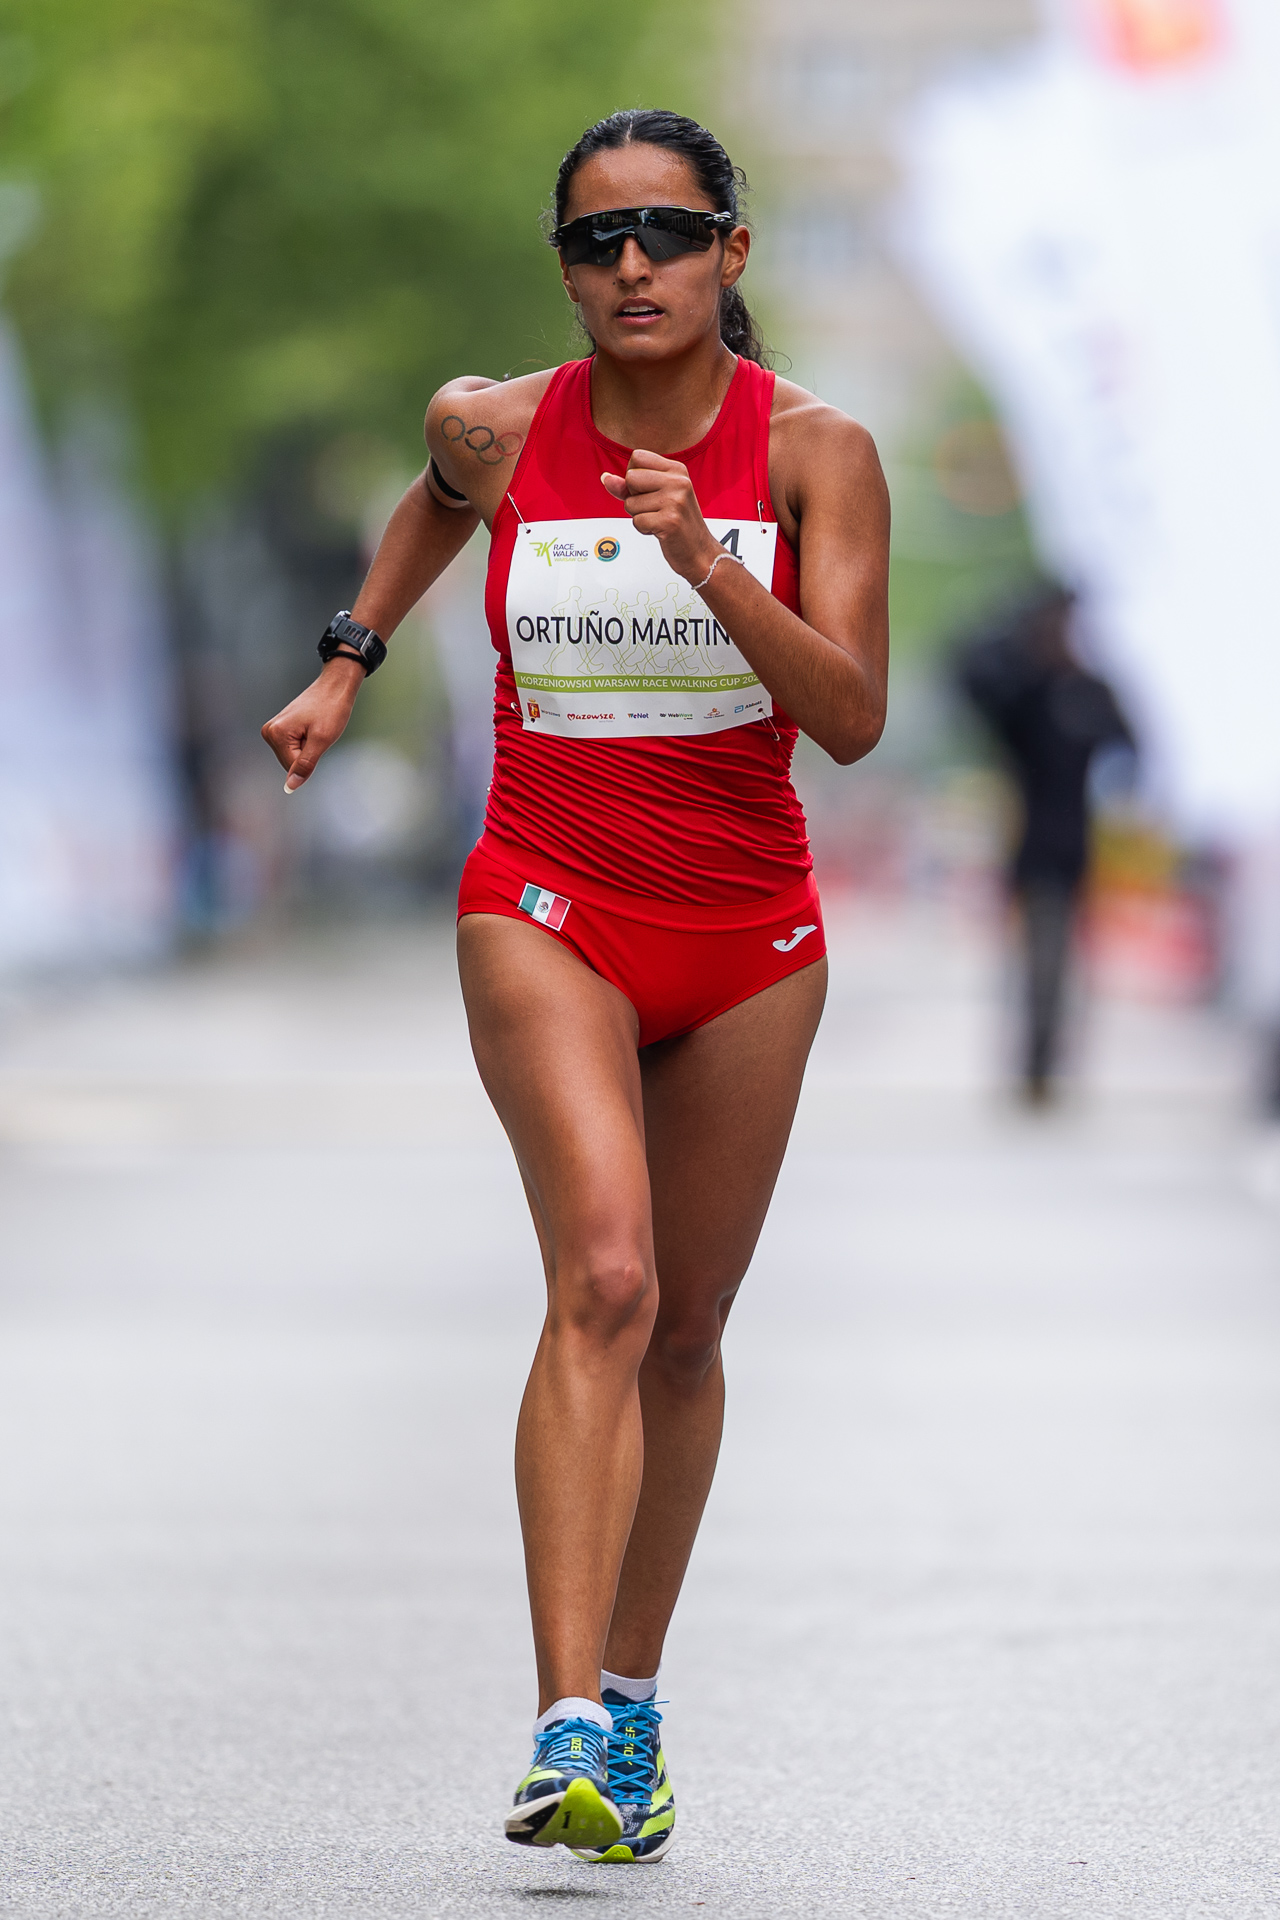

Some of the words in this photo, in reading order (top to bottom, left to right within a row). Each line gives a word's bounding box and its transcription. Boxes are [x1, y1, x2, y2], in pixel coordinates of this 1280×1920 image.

[516, 610, 624, 645] ORTUÑO
[632, 617, 734, 646] MARTIN
[520, 675, 592, 688] KORZENIOWSKI
[594, 678, 640, 688] WARSAW
[642, 678, 668, 688] RACE
[669, 678, 718, 688] WALKING
[720, 677, 741, 687] CUP
